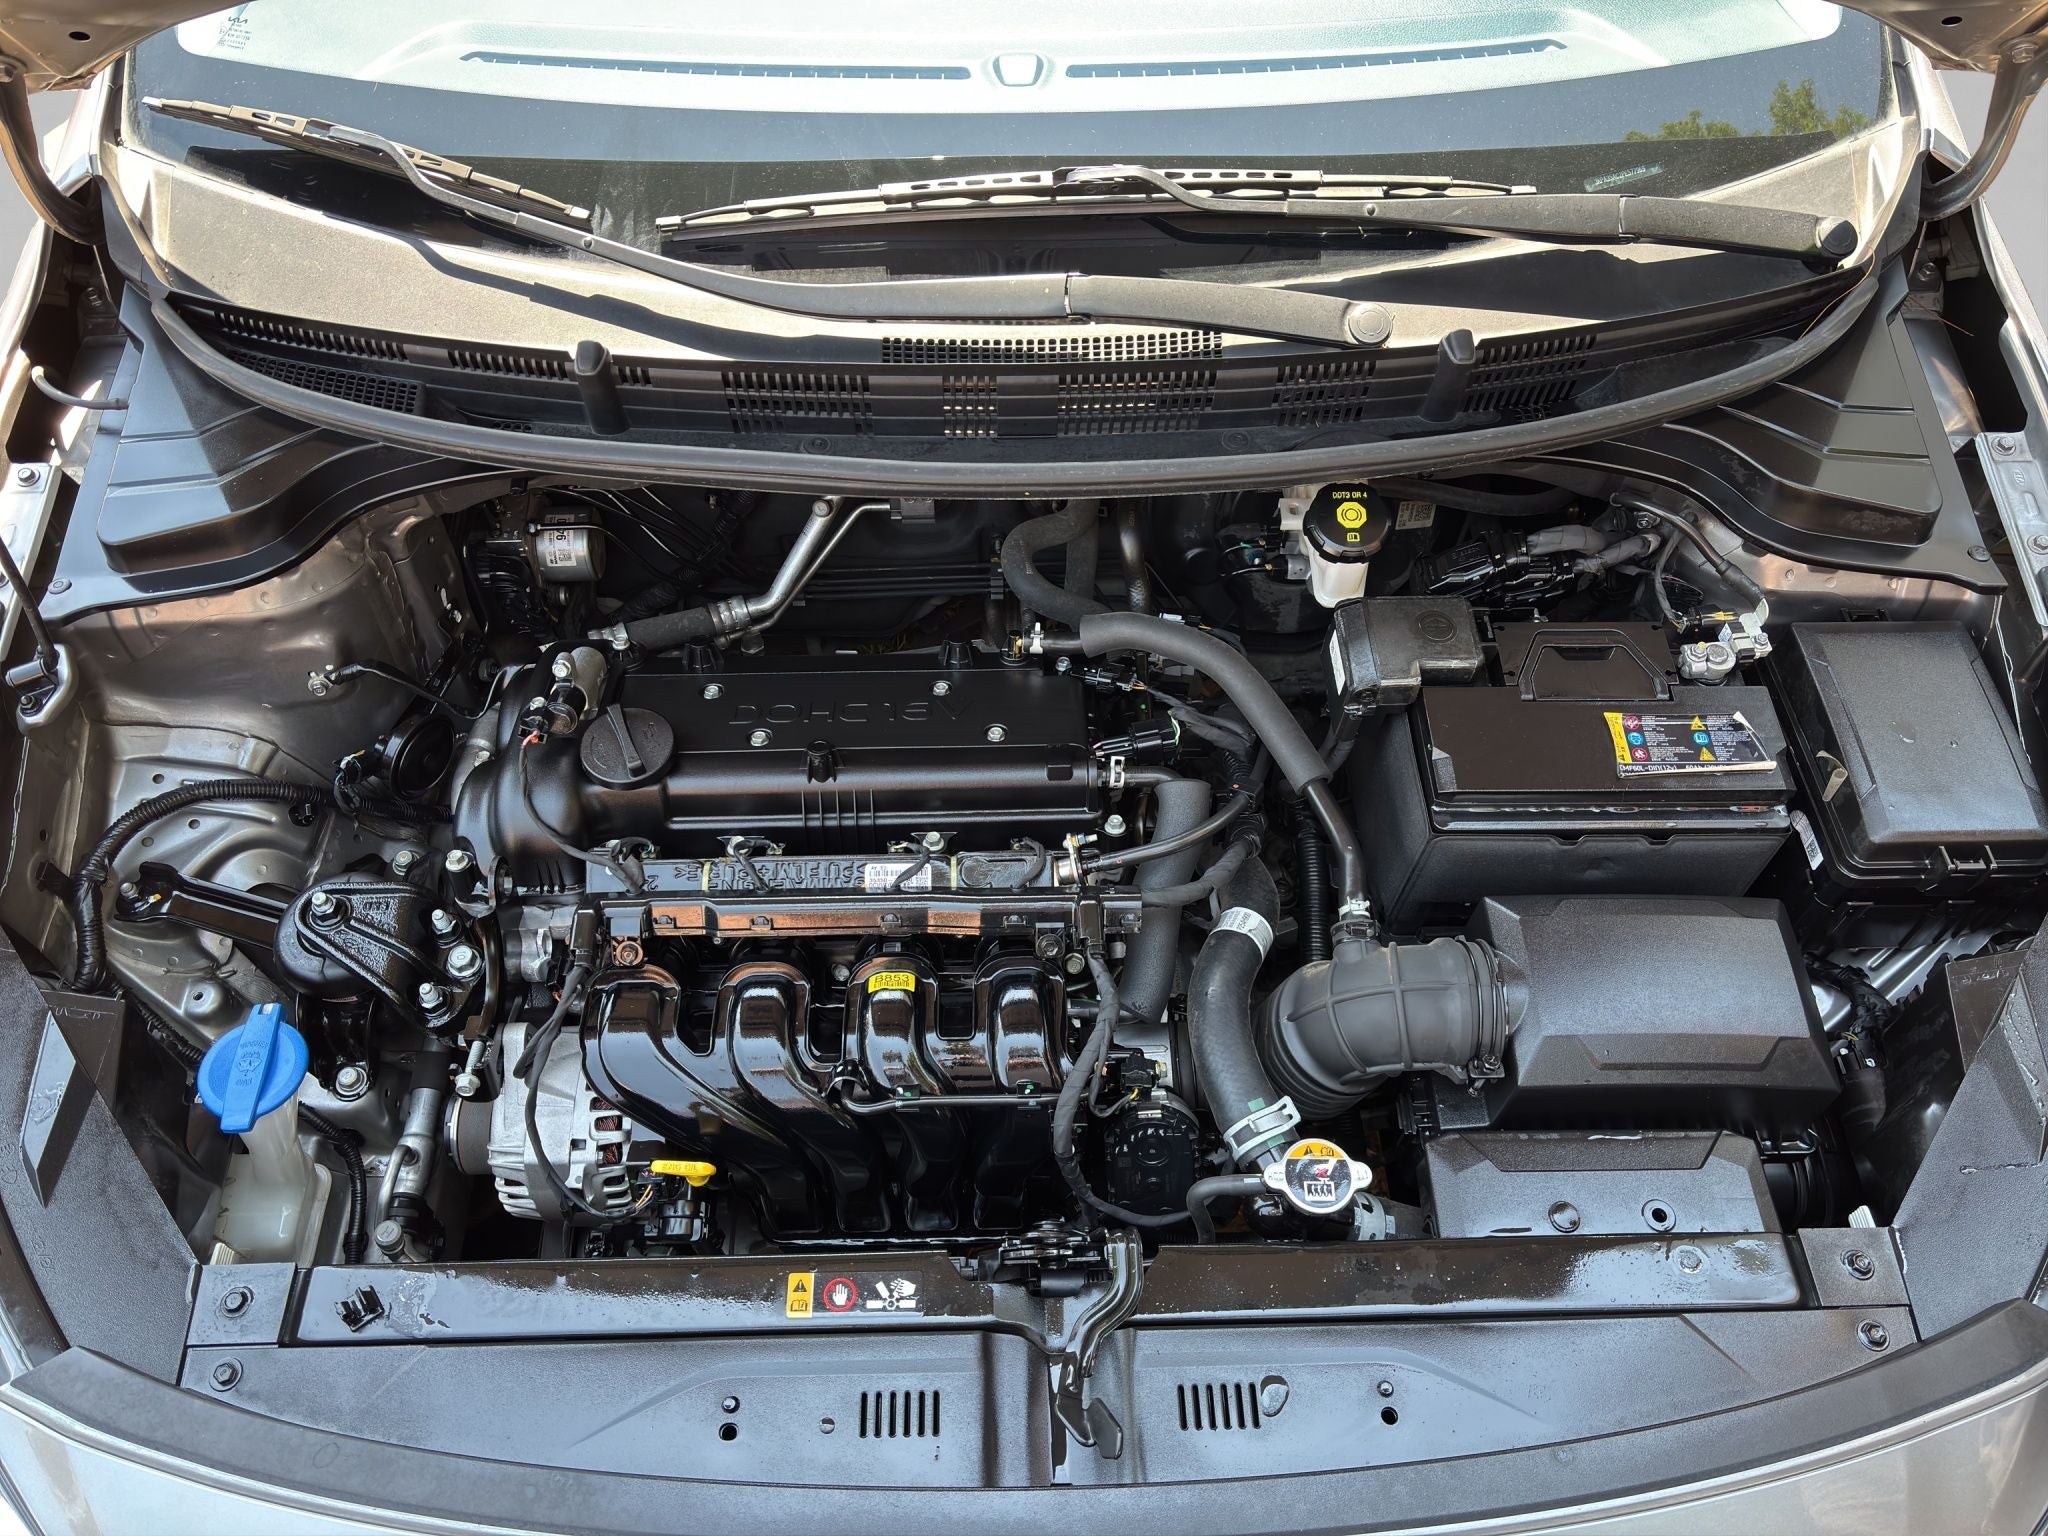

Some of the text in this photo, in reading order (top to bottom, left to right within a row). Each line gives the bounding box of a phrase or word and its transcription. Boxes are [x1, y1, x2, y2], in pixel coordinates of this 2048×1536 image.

[728, 704, 870, 724] DOHC
[709, 877, 787, 891] EGINE
[875, 974, 910, 983] B853
